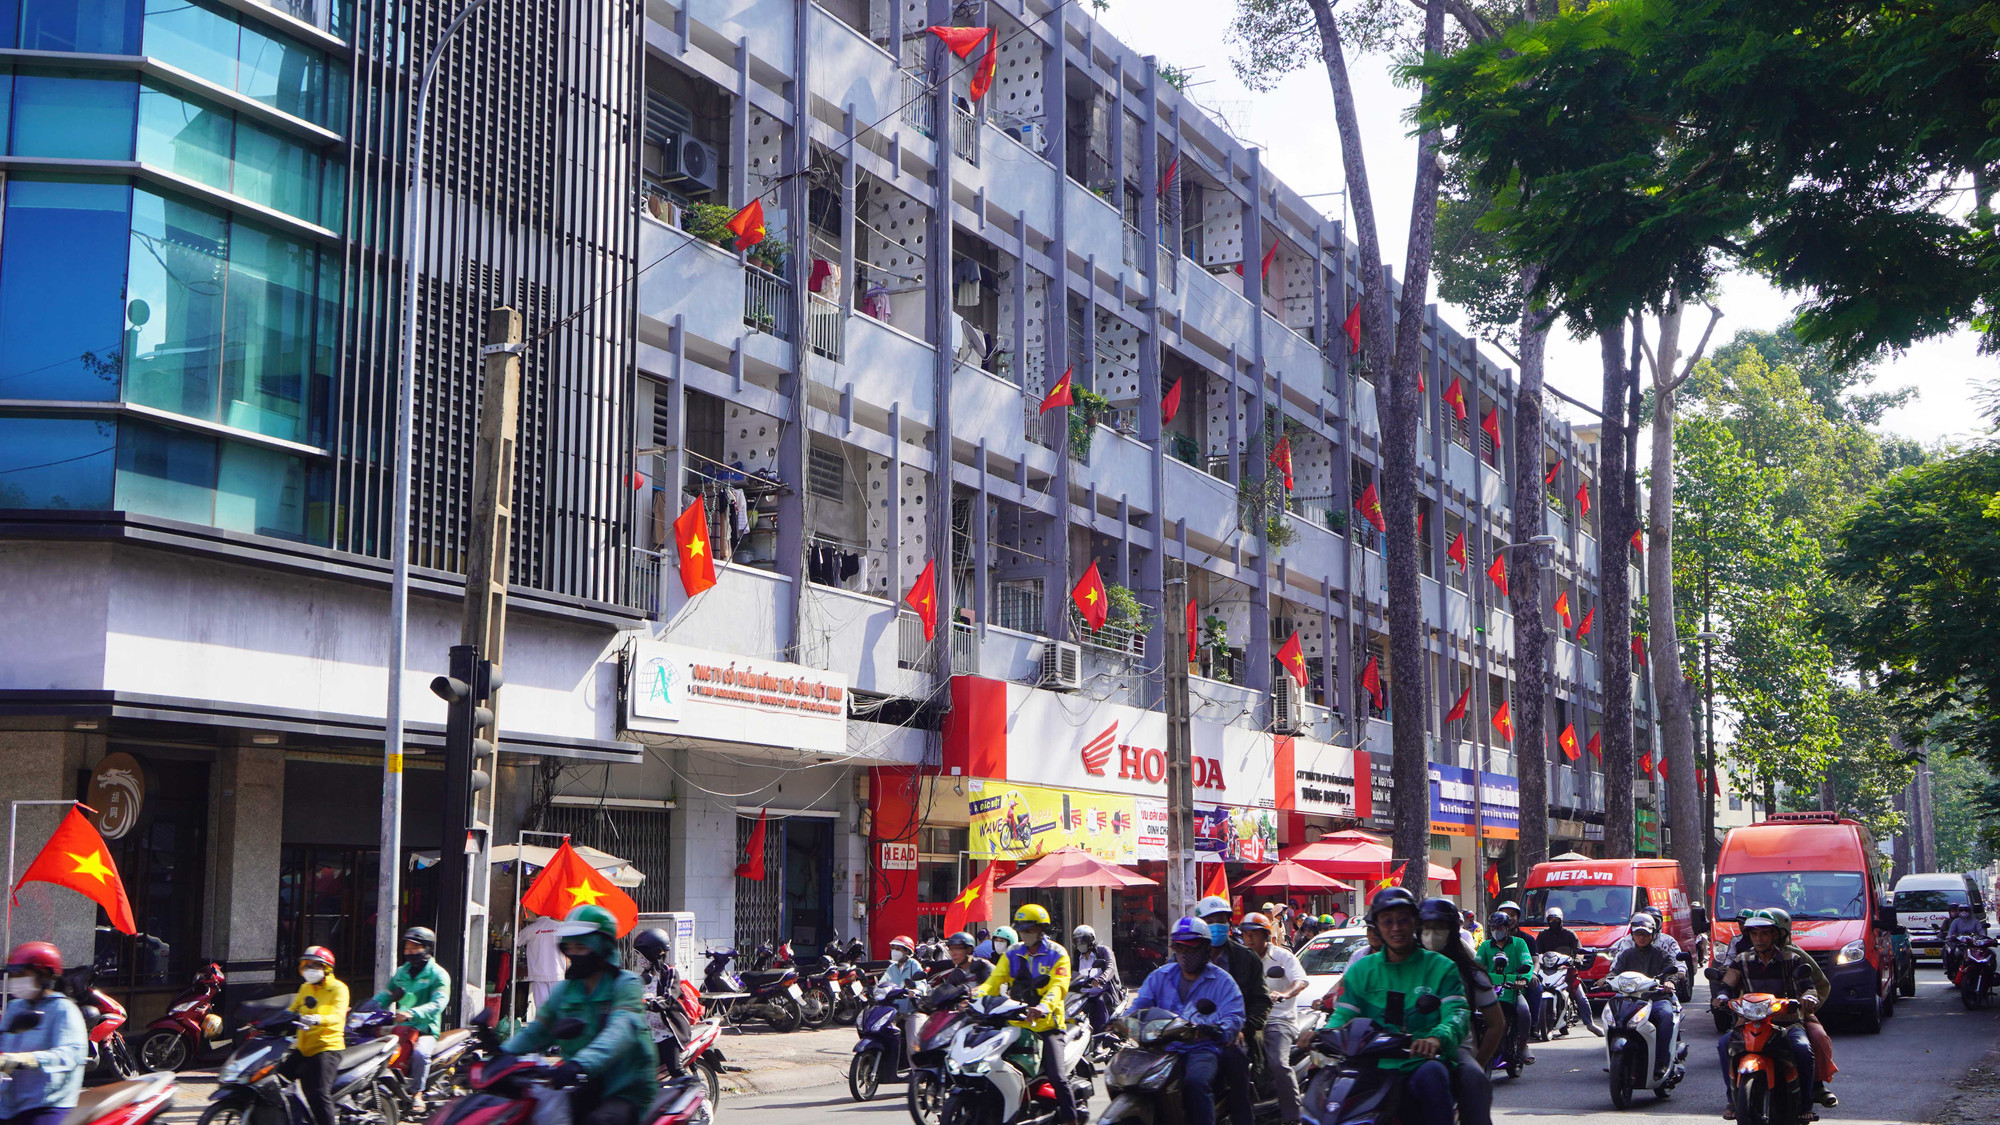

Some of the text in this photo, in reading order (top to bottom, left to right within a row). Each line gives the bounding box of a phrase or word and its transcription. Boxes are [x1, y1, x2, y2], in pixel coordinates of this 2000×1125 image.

[826, 686, 843, 702] NAM
[1118, 744, 1227, 791] HODA
[1346, 793, 1351, 805] 2
[979, 817, 1003, 838] WAVE
[884, 846, 916, 862] HEAD
[1545, 869, 1614, 882] META.vn
